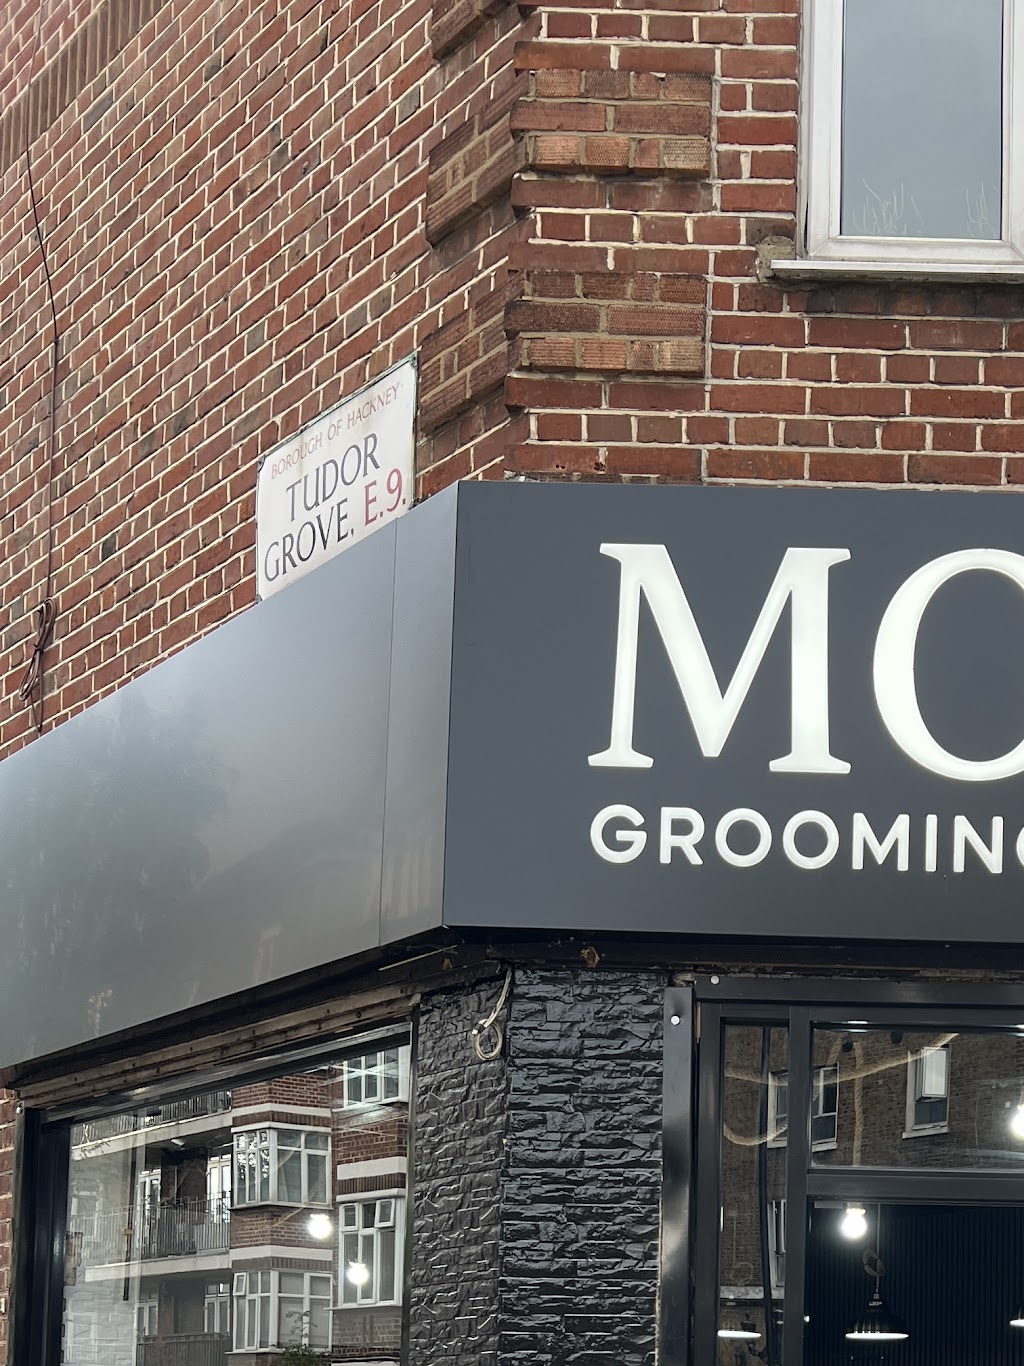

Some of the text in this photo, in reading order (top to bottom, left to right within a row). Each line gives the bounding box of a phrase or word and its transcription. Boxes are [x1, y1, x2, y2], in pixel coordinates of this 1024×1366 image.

[271, 382, 400, 480] BOROUGH OF HACKNEY
[286, 433, 380, 522] TUDOR
[264, 498, 355, 582] GROVE,
